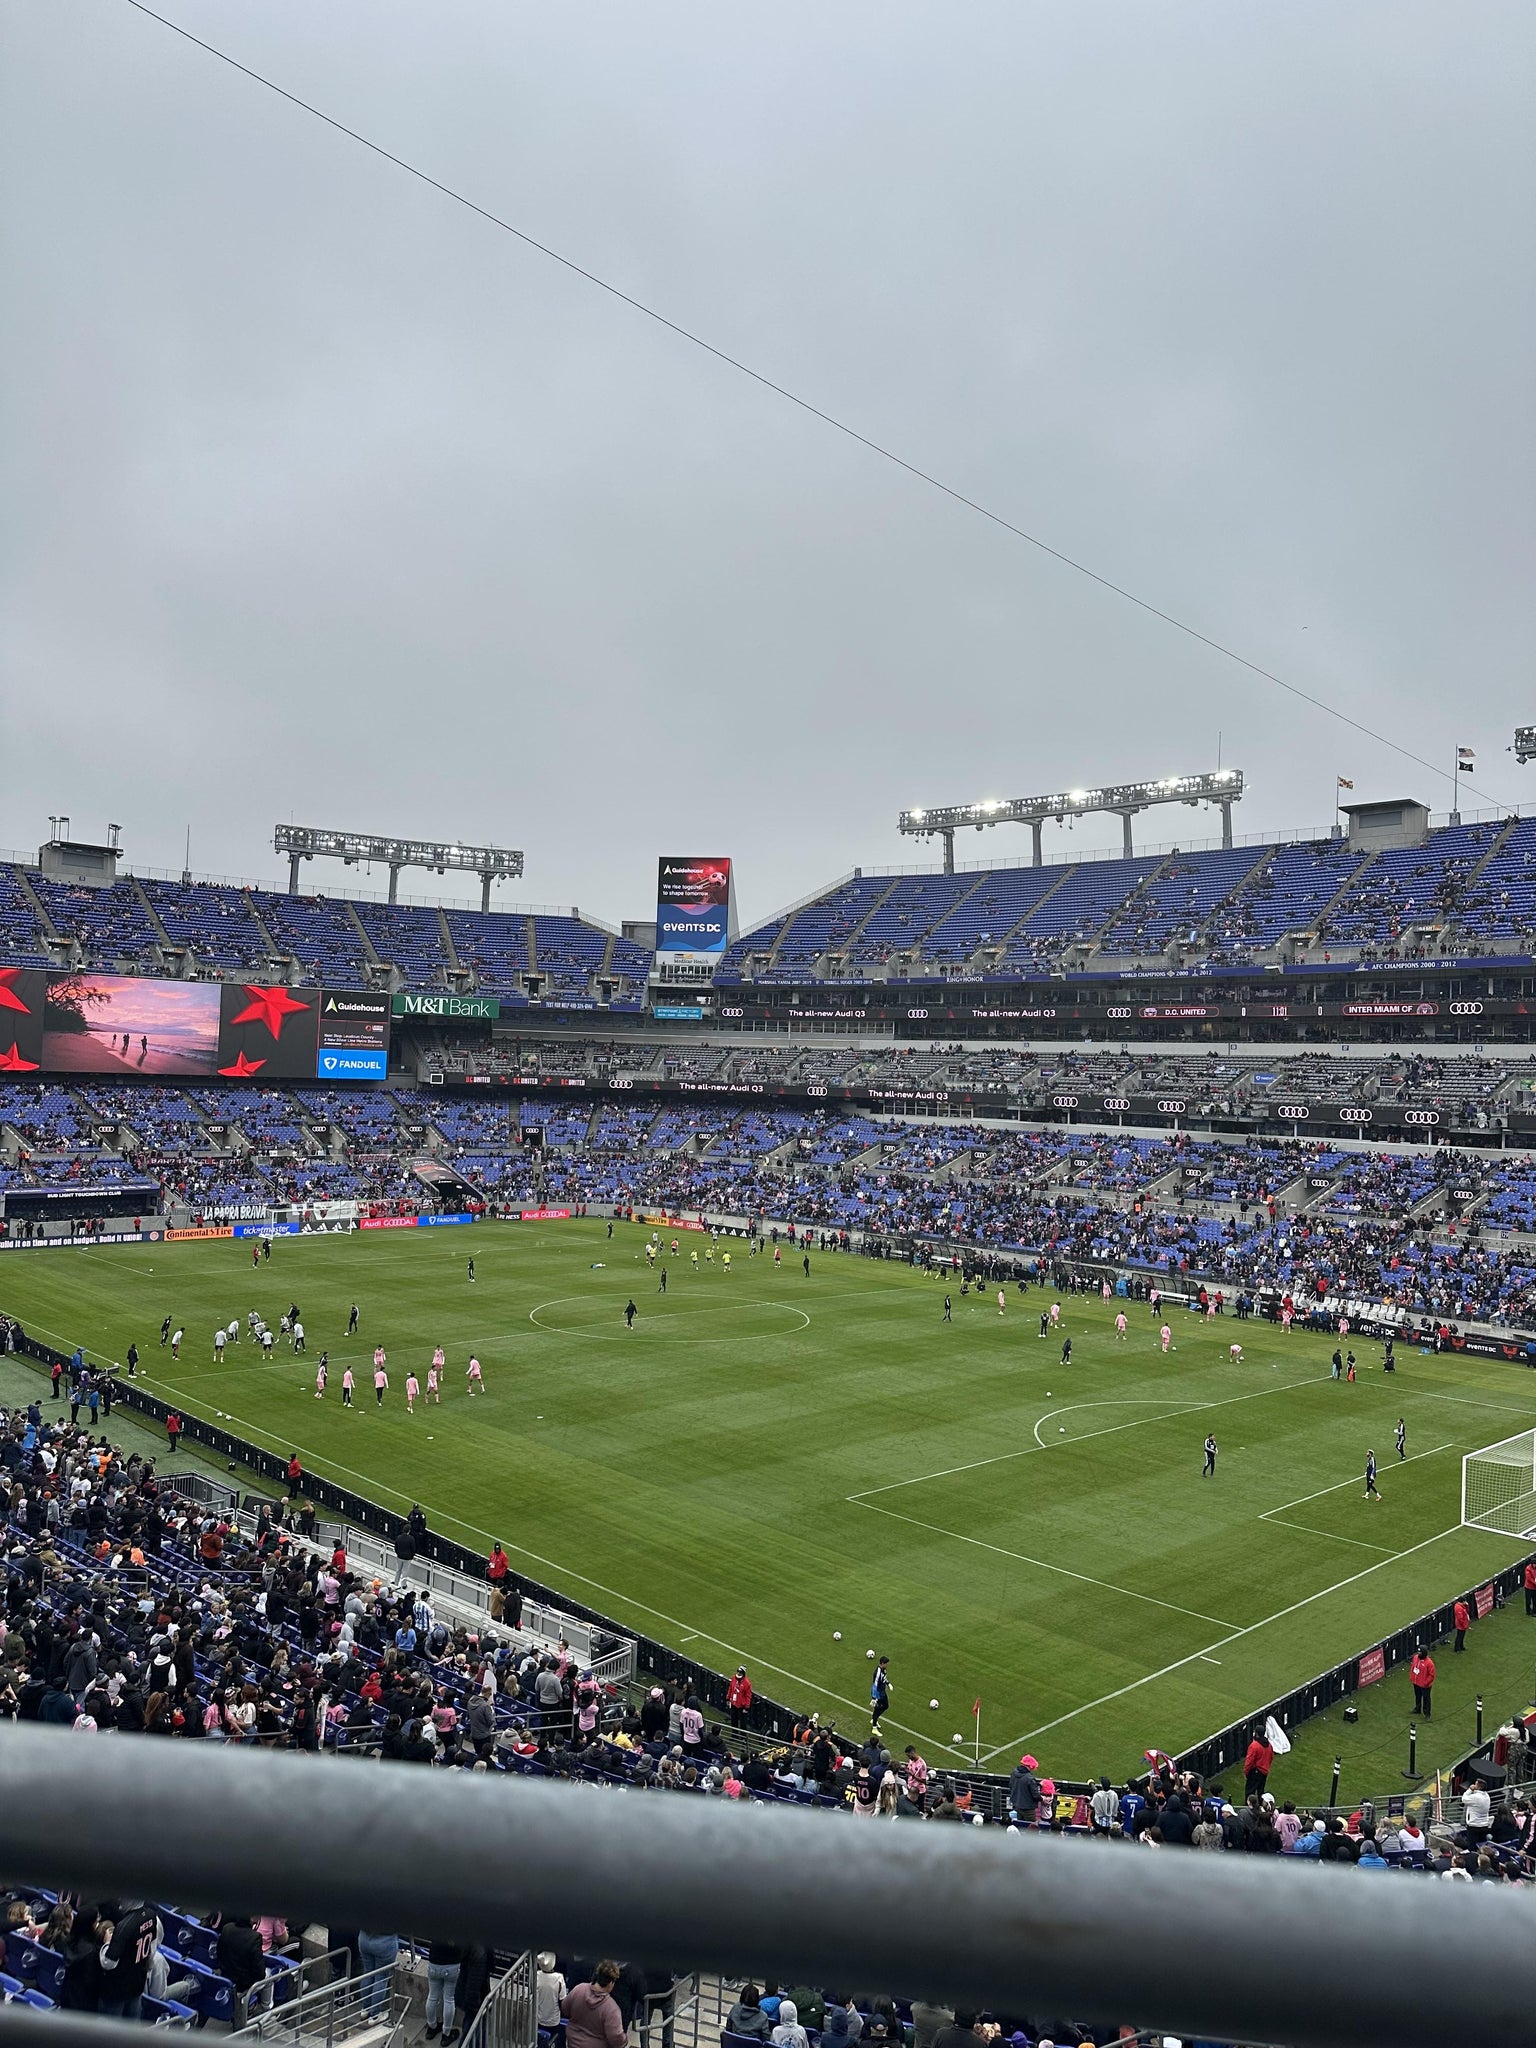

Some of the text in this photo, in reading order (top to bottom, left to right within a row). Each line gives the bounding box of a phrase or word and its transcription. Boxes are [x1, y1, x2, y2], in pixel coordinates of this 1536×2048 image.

[706, 924, 720, 932] DC
[1385, 962, 1419, 970] CHAMPIONS
[338, 1003, 385, 1012] Guidehouse
[404, 996, 489, 1017] M&T Bank
[1349, 1006, 1373, 1014] INTER
[1402, 1005, 1412, 1013] CF
[855, 1010, 866, 1018] Q3
[339, 1060, 381, 1069] FANDUEL
[680, 1082, 763, 1093] The all-new Audi Q3
[884, 1090, 913, 1098] all-new
[915, 1091, 934, 1099] Audi
[203, 1207, 213, 1220] LA
[166, 1227, 232, 1239] Continental Tire
[243, 1225, 290, 1235] ticketmaster
[73, 1236, 98, 1244] budget.
[684, 1717, 694, 1729] 10
[857, 1786, 870, 1799] 10
[1130, 1803, 1135, 1818] 7
[1286, 1823, 1296, 1832] 10
[135, 1932, 153, 1964] 10
